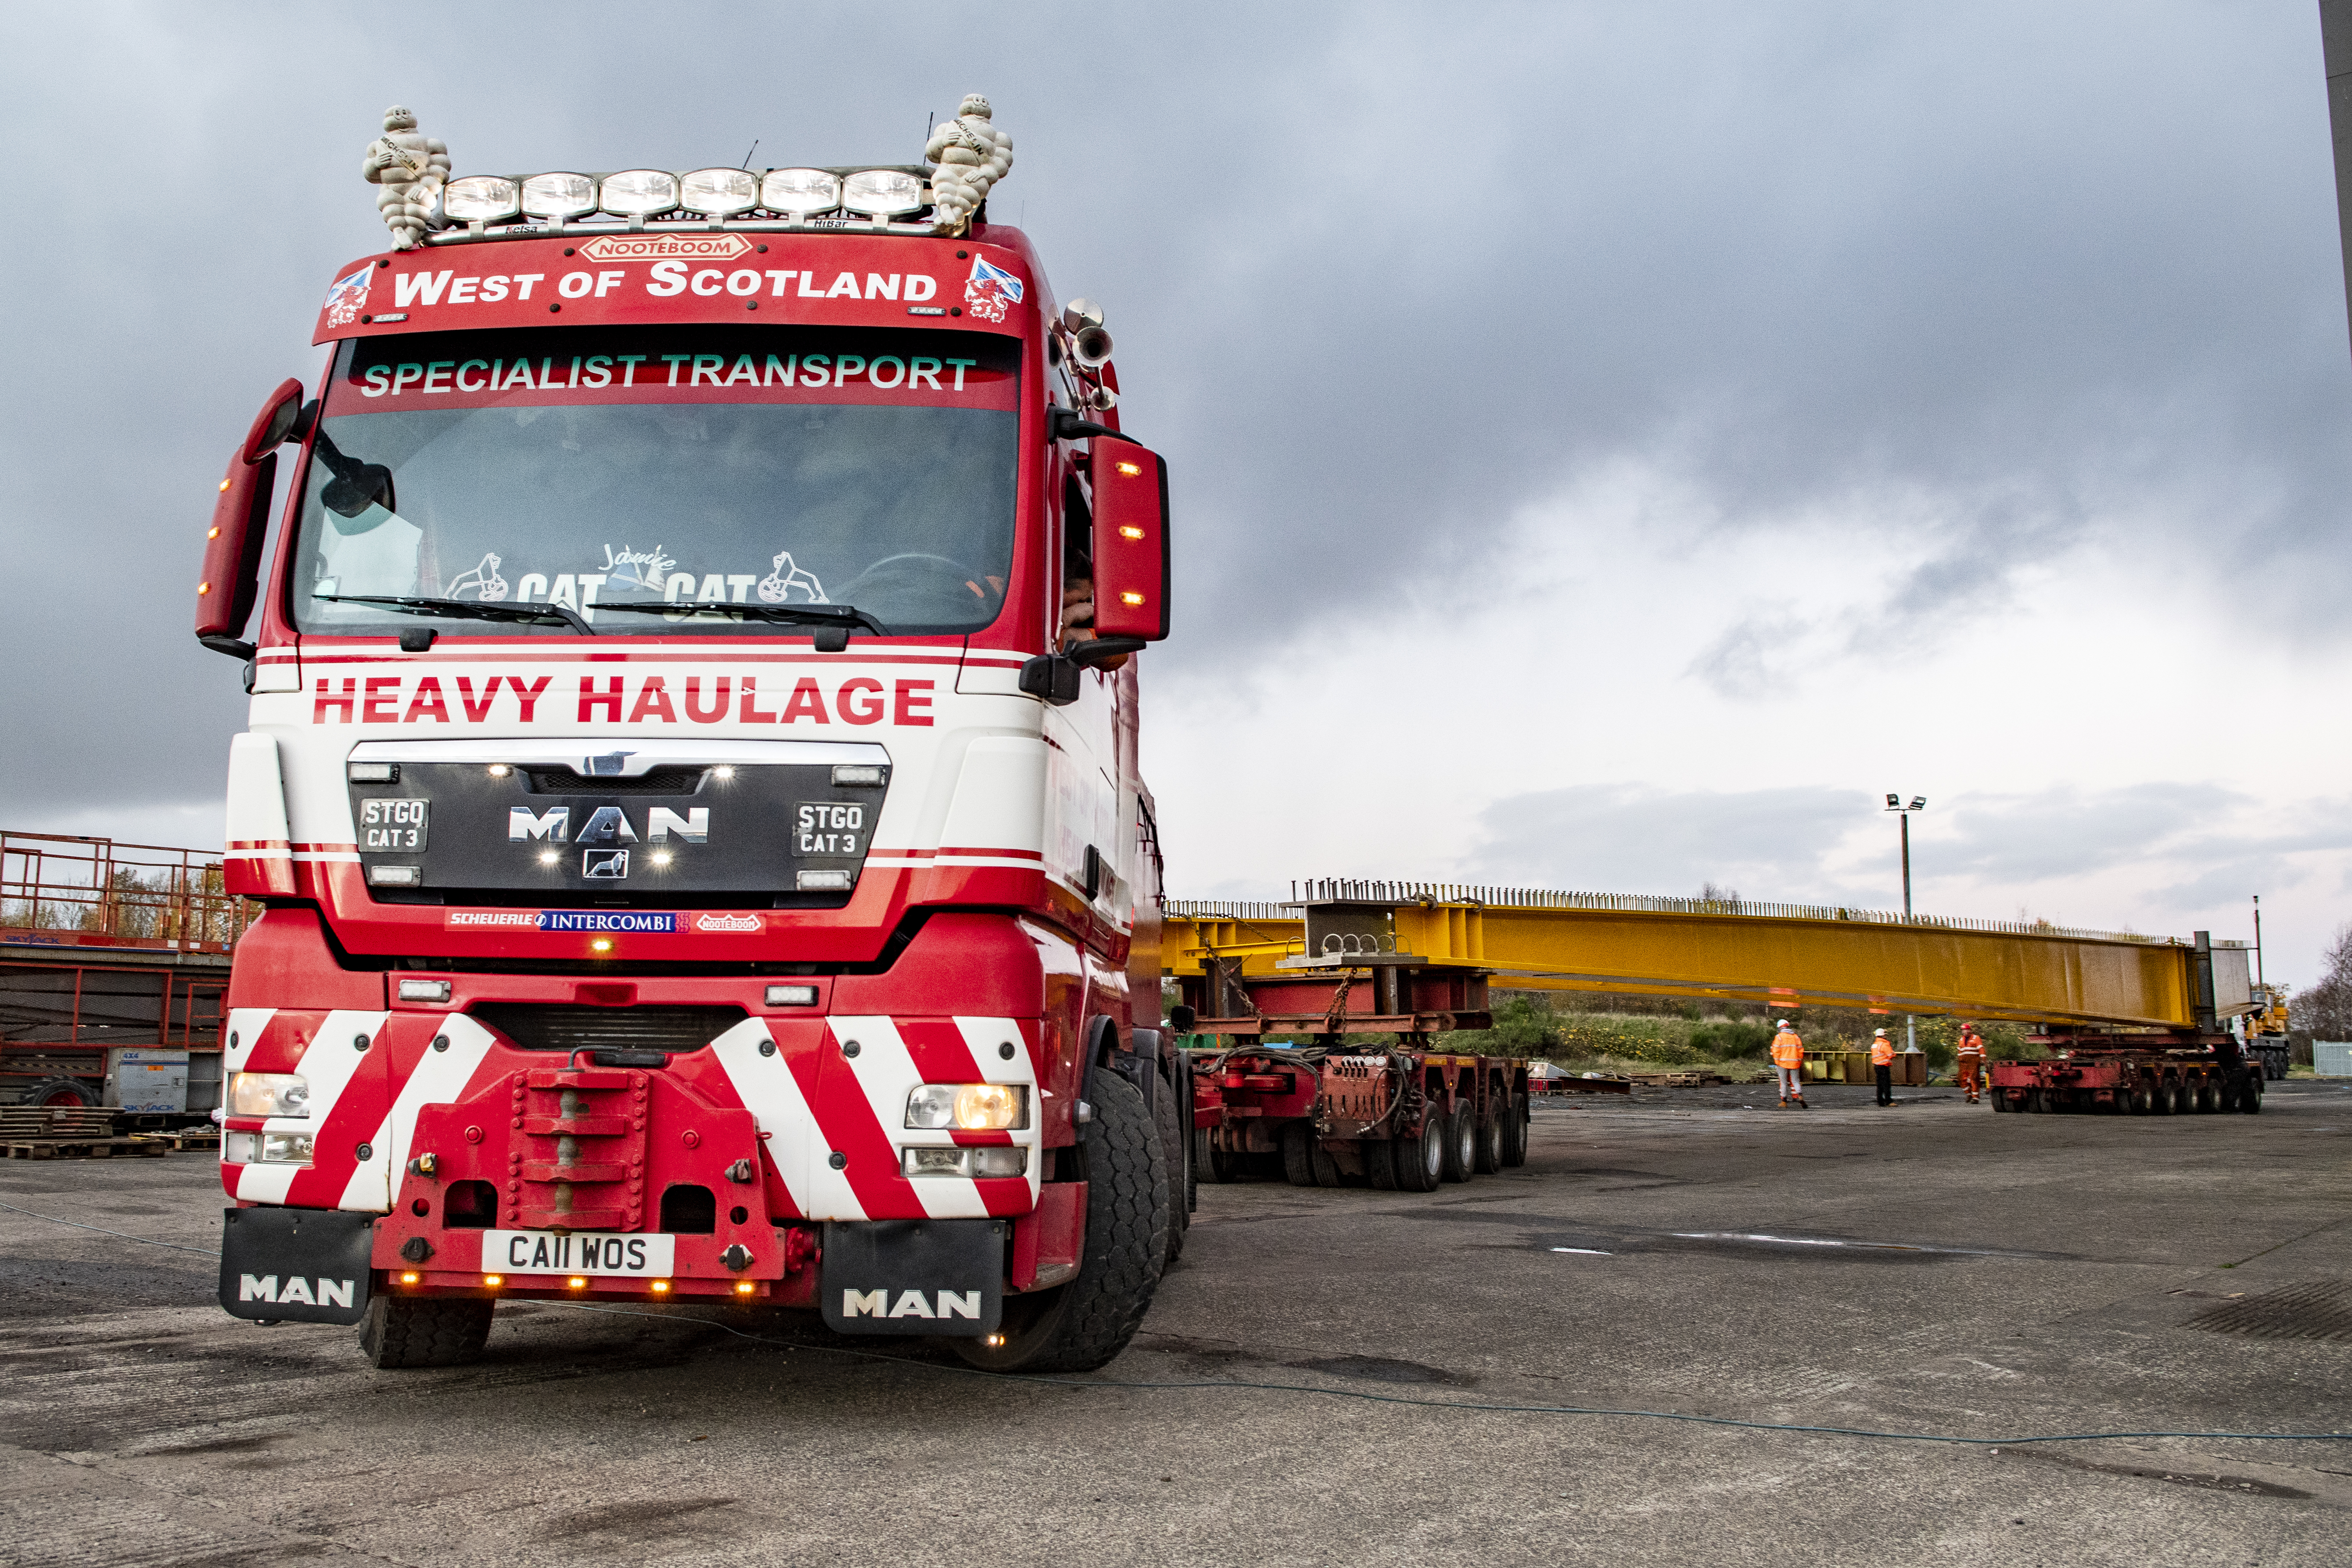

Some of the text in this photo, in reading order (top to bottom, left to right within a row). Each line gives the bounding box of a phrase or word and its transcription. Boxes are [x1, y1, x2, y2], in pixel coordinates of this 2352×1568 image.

[505, 224, 537, 234] Kelsa
[814, 219, 848, 228] HiBar
[598, 241, 730, 255] NOOTEBOOM
[395, 260, 937, 307] WEST OF SCOTLAND
[360, 354, 977, 398] SPECIALIST TRANSPORT
[598, 543, 677, 571] Jamie
[515, 572, 757, 623] CAT CAT
[312, 676, 935, 727] HEAVY HAULAGE
[365, 801, 424, 823] STGO
[799, 806, 862, 829] STGO
[508, 806, 710, 844] MAN
[367, 829, 418, 847] CAT 3
[801, 834, 855, 853] CAT 3
[450, 913, 533, 925] SCHEUERLE
[551, 914, 671, 930] INTERCOMBI
[702, 920, 755, 929] NOOTEBOOM
[124, 1102, 174, 1112] SKYJACK
[582, 1237, 646, 1270] WOS
[239, 1274, 355, 1308] MAN
[843, 1289, 981, 1319] MAN
